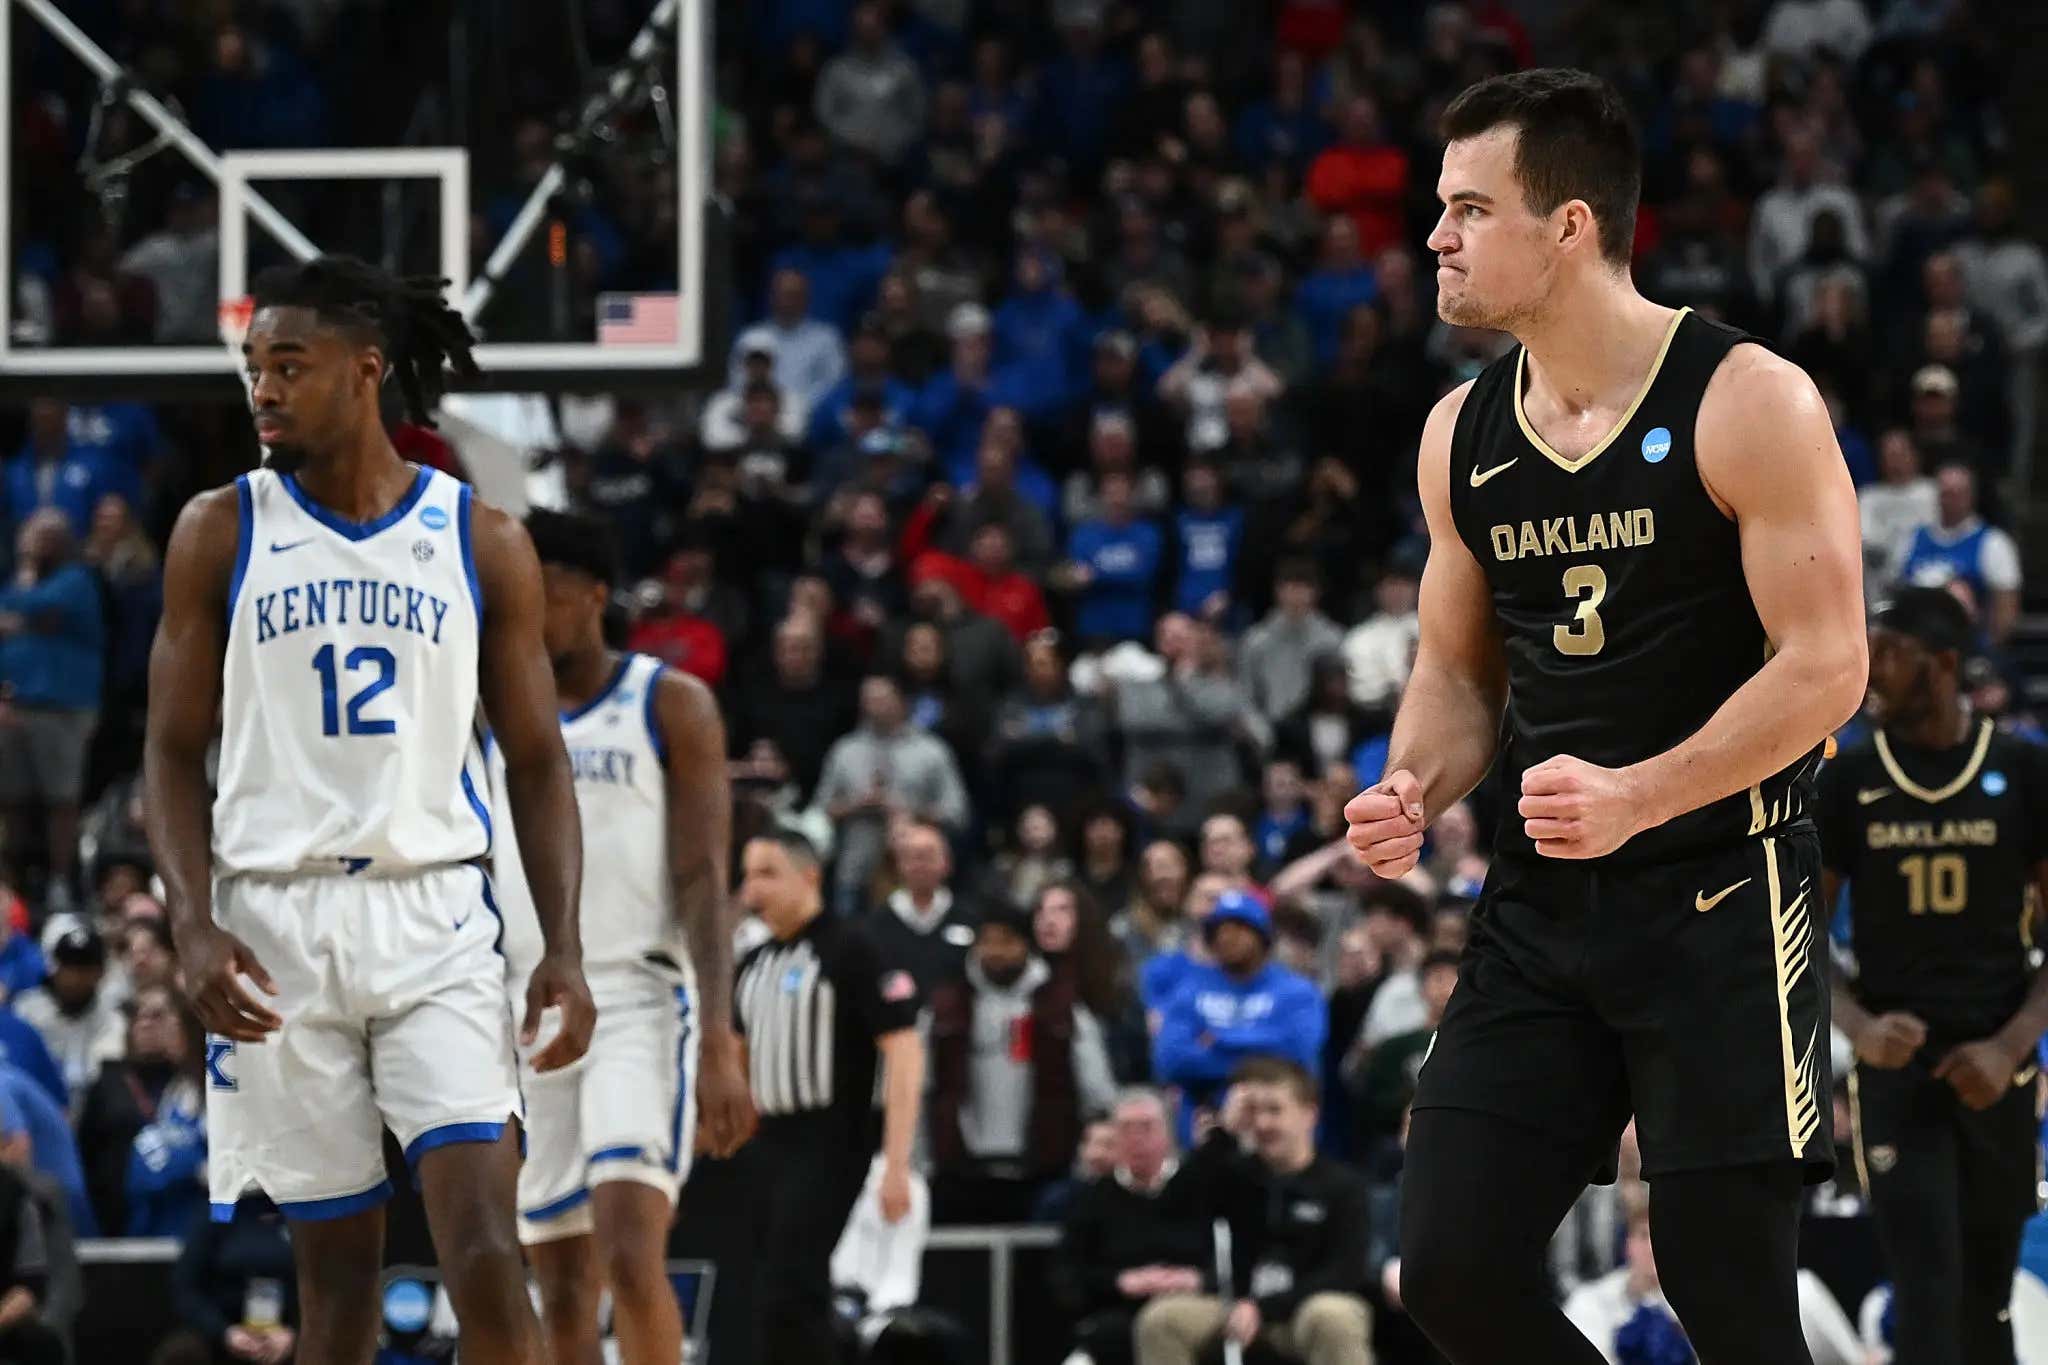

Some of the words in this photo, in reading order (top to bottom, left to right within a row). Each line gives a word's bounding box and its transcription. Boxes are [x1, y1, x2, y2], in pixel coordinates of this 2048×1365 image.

[1490, 508, 1655, 561] OAKLAND
[256, 579, 448, 644] KENTUCKY
[1553, 564, 1607, 656] 3
[312, 643, 396, 736] 12
[1867, 818, 1998, 849] OAKLAND
[1898, 854, 1967, 915] 10
